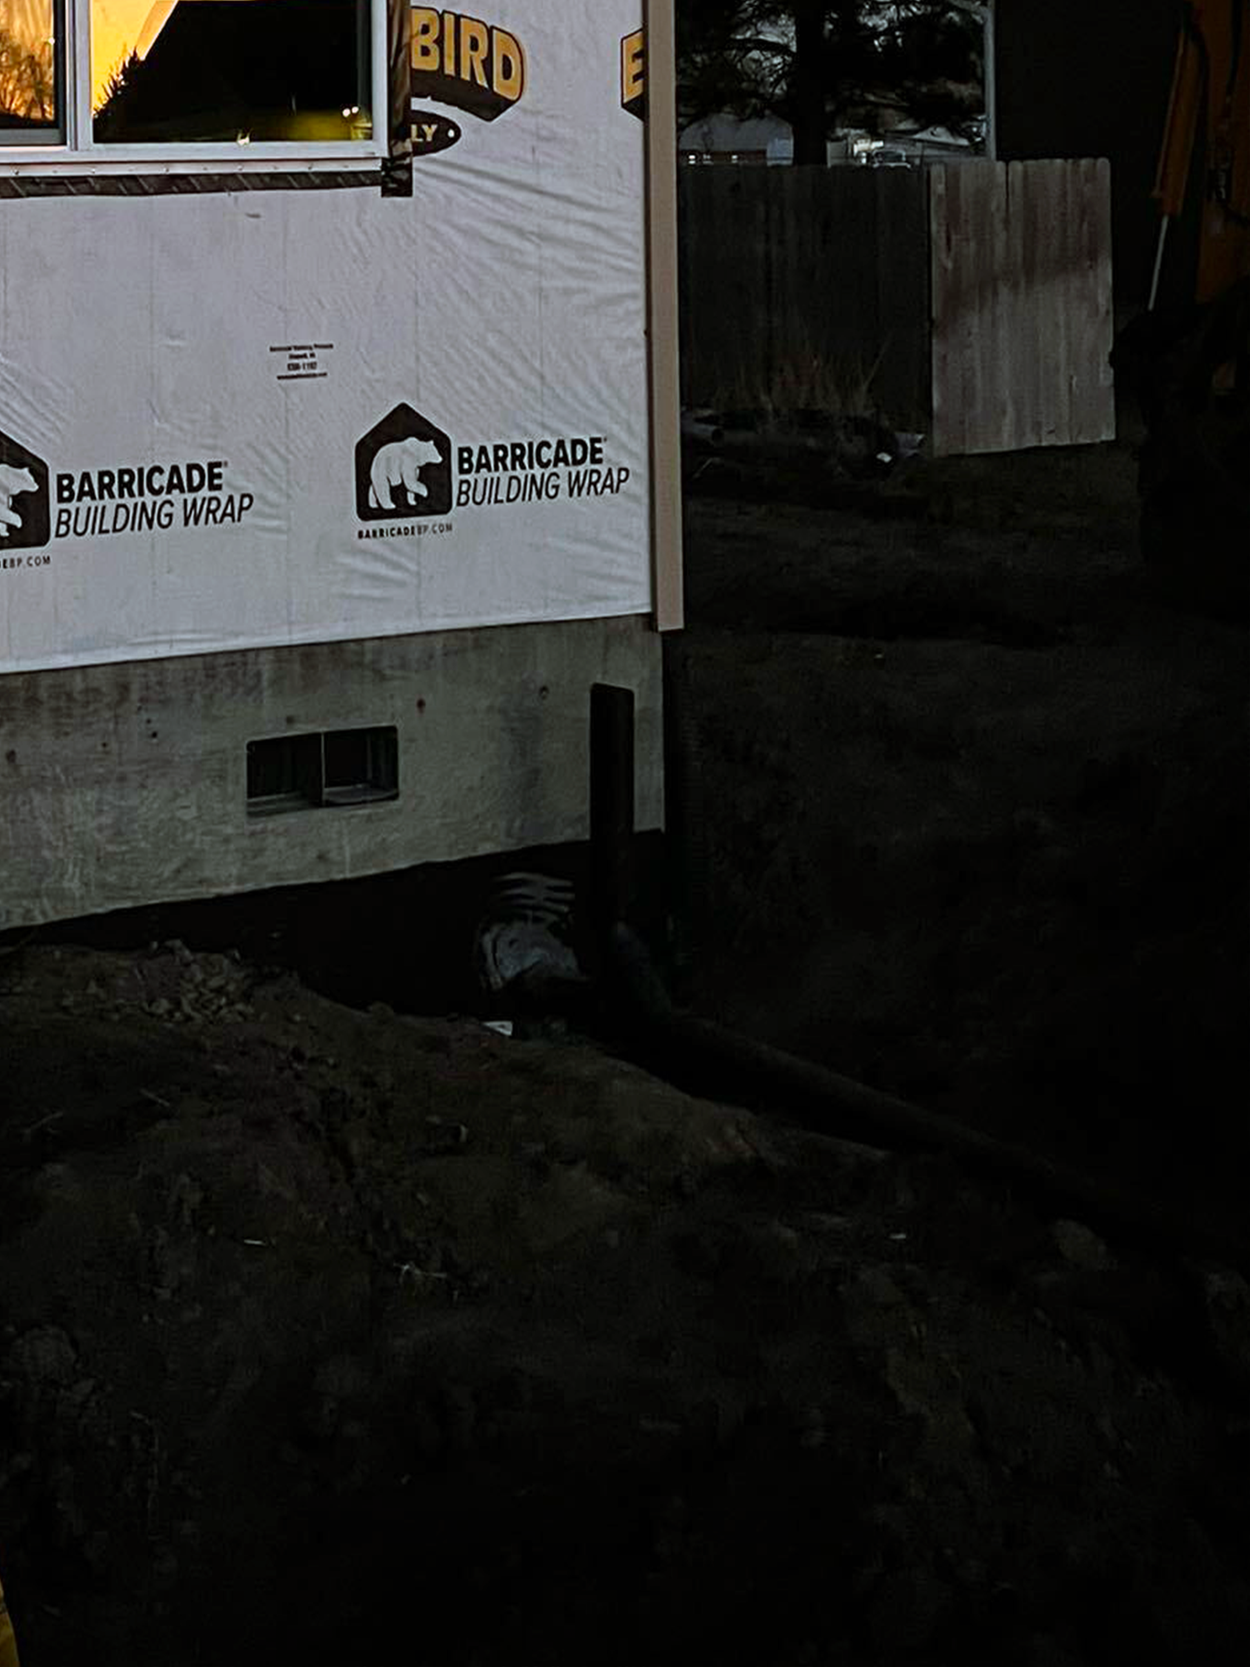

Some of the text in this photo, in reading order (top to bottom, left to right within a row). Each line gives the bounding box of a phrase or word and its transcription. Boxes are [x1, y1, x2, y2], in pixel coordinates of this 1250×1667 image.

[410, 6, 524, 102] BIRD
[457, 437, 604, 475] BARRICADE
[56, 461, 225, 504] BARRICADE
[456, 467, 630, 508] BUILDING WRAP
[55, 493, 254, 539] BUILDING WRAP
[357, 522, 454, 540] BARRICADEBP.COM
